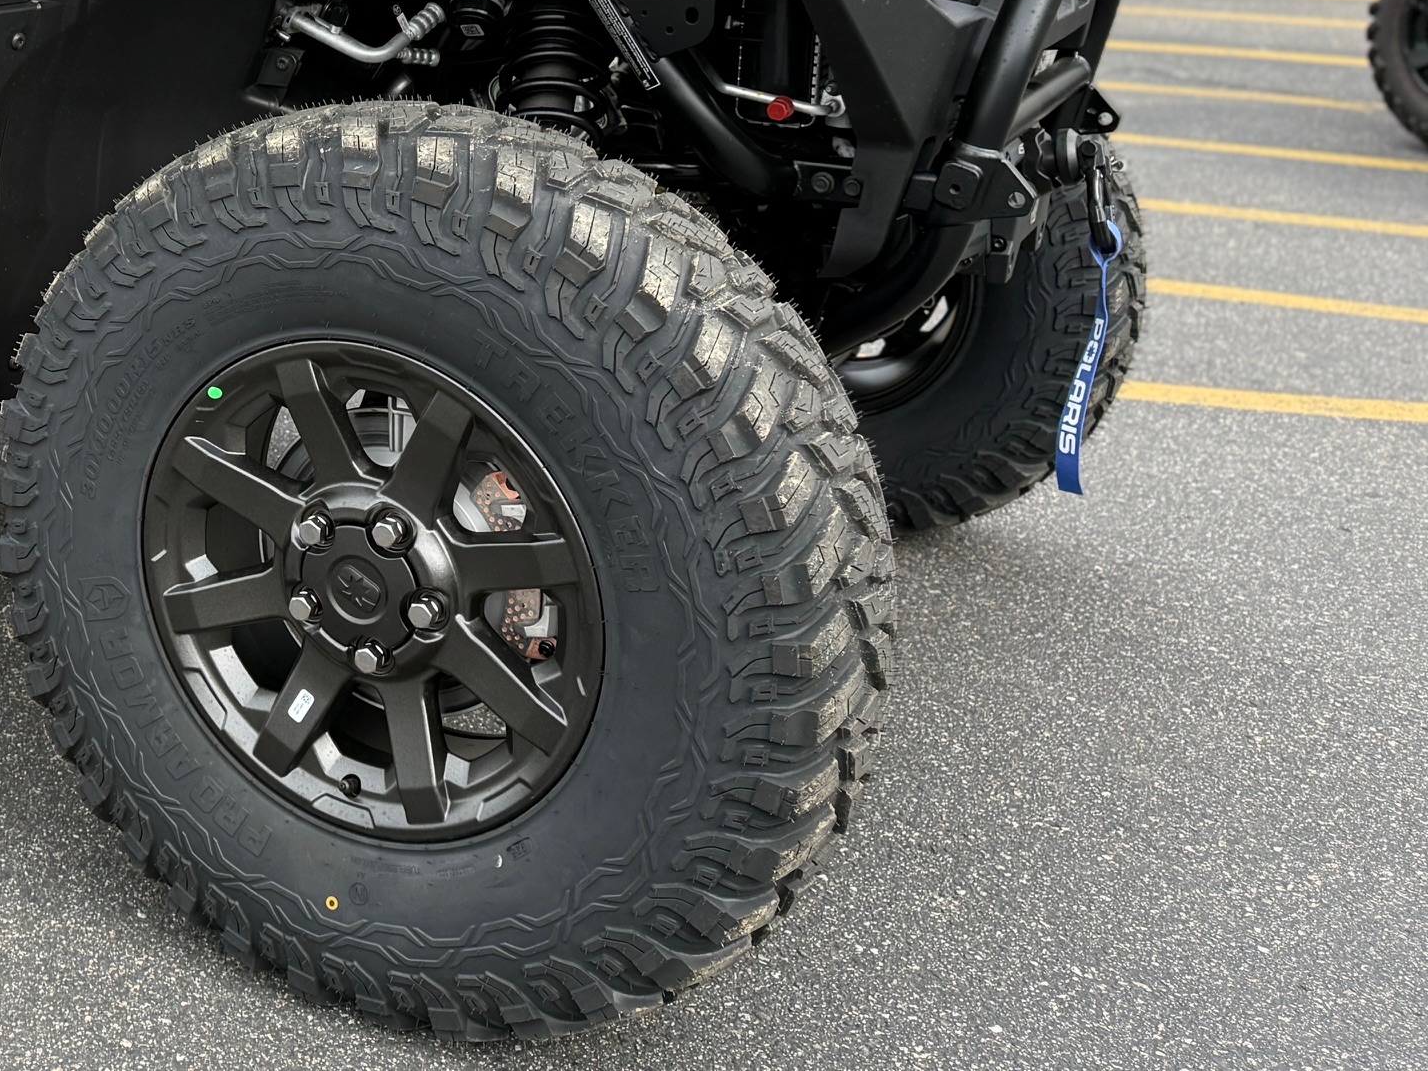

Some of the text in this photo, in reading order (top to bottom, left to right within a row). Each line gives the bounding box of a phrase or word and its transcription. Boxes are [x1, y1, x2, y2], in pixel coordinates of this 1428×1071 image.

[471, 327, 660, 592] TREKKER
[1058, 317, 1105, 456] POLARIS
[98, 626, 274, 858] PRO ARMOR
